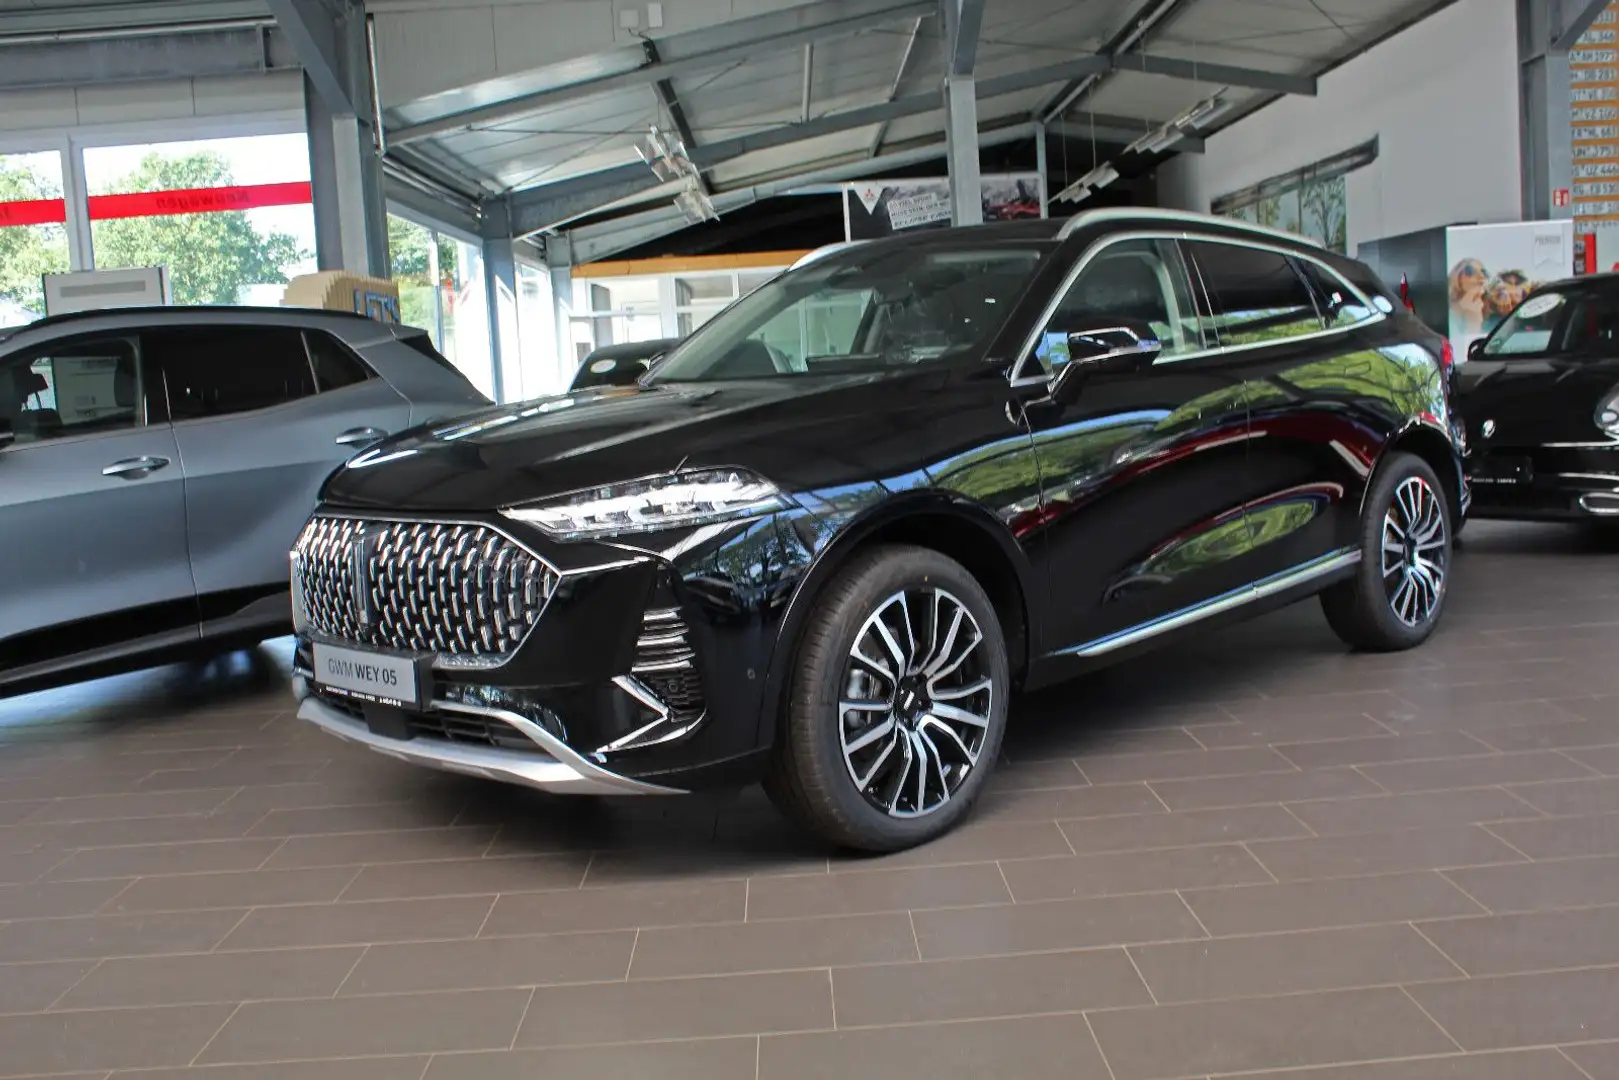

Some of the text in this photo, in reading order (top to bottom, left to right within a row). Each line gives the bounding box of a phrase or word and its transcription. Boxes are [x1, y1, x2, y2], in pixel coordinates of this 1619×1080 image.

[328, 657, 398, 686] GWM WEY 05
